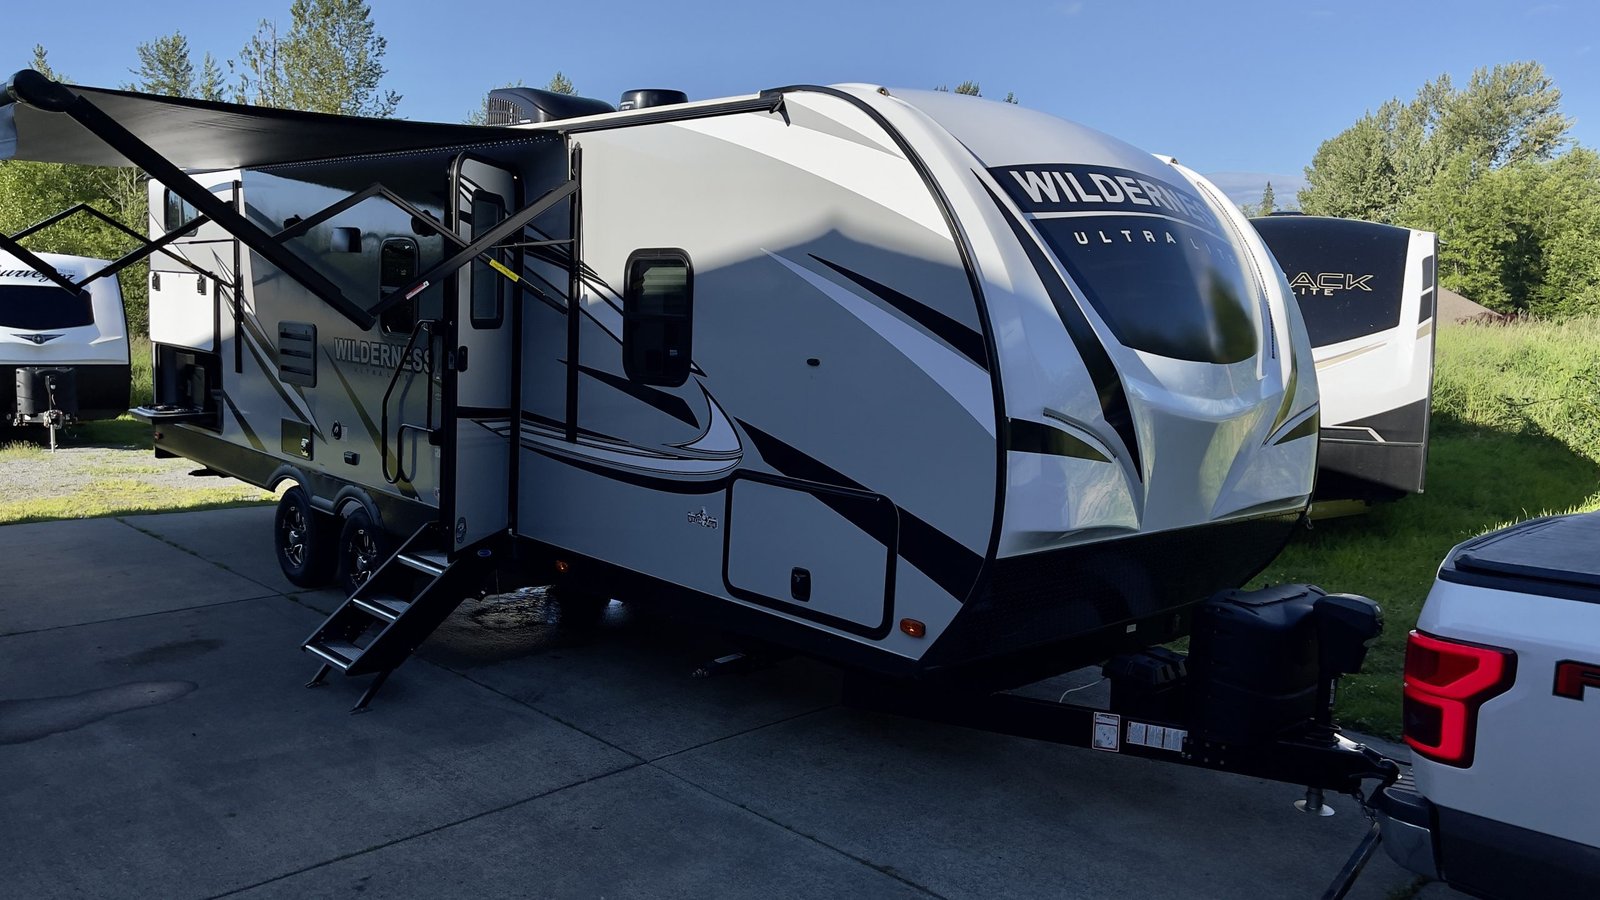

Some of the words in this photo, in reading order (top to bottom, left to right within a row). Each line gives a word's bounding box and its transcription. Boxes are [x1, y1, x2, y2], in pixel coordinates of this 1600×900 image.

[1009, 170, 1218, 229] WILDERNES
[1074, 230, 1176, 245] ULTRA
[0, 264, 75, 282] urveyr
[1290, 272, 1374, 291] ACK
[1293, 287, 1334, 296] ITE
